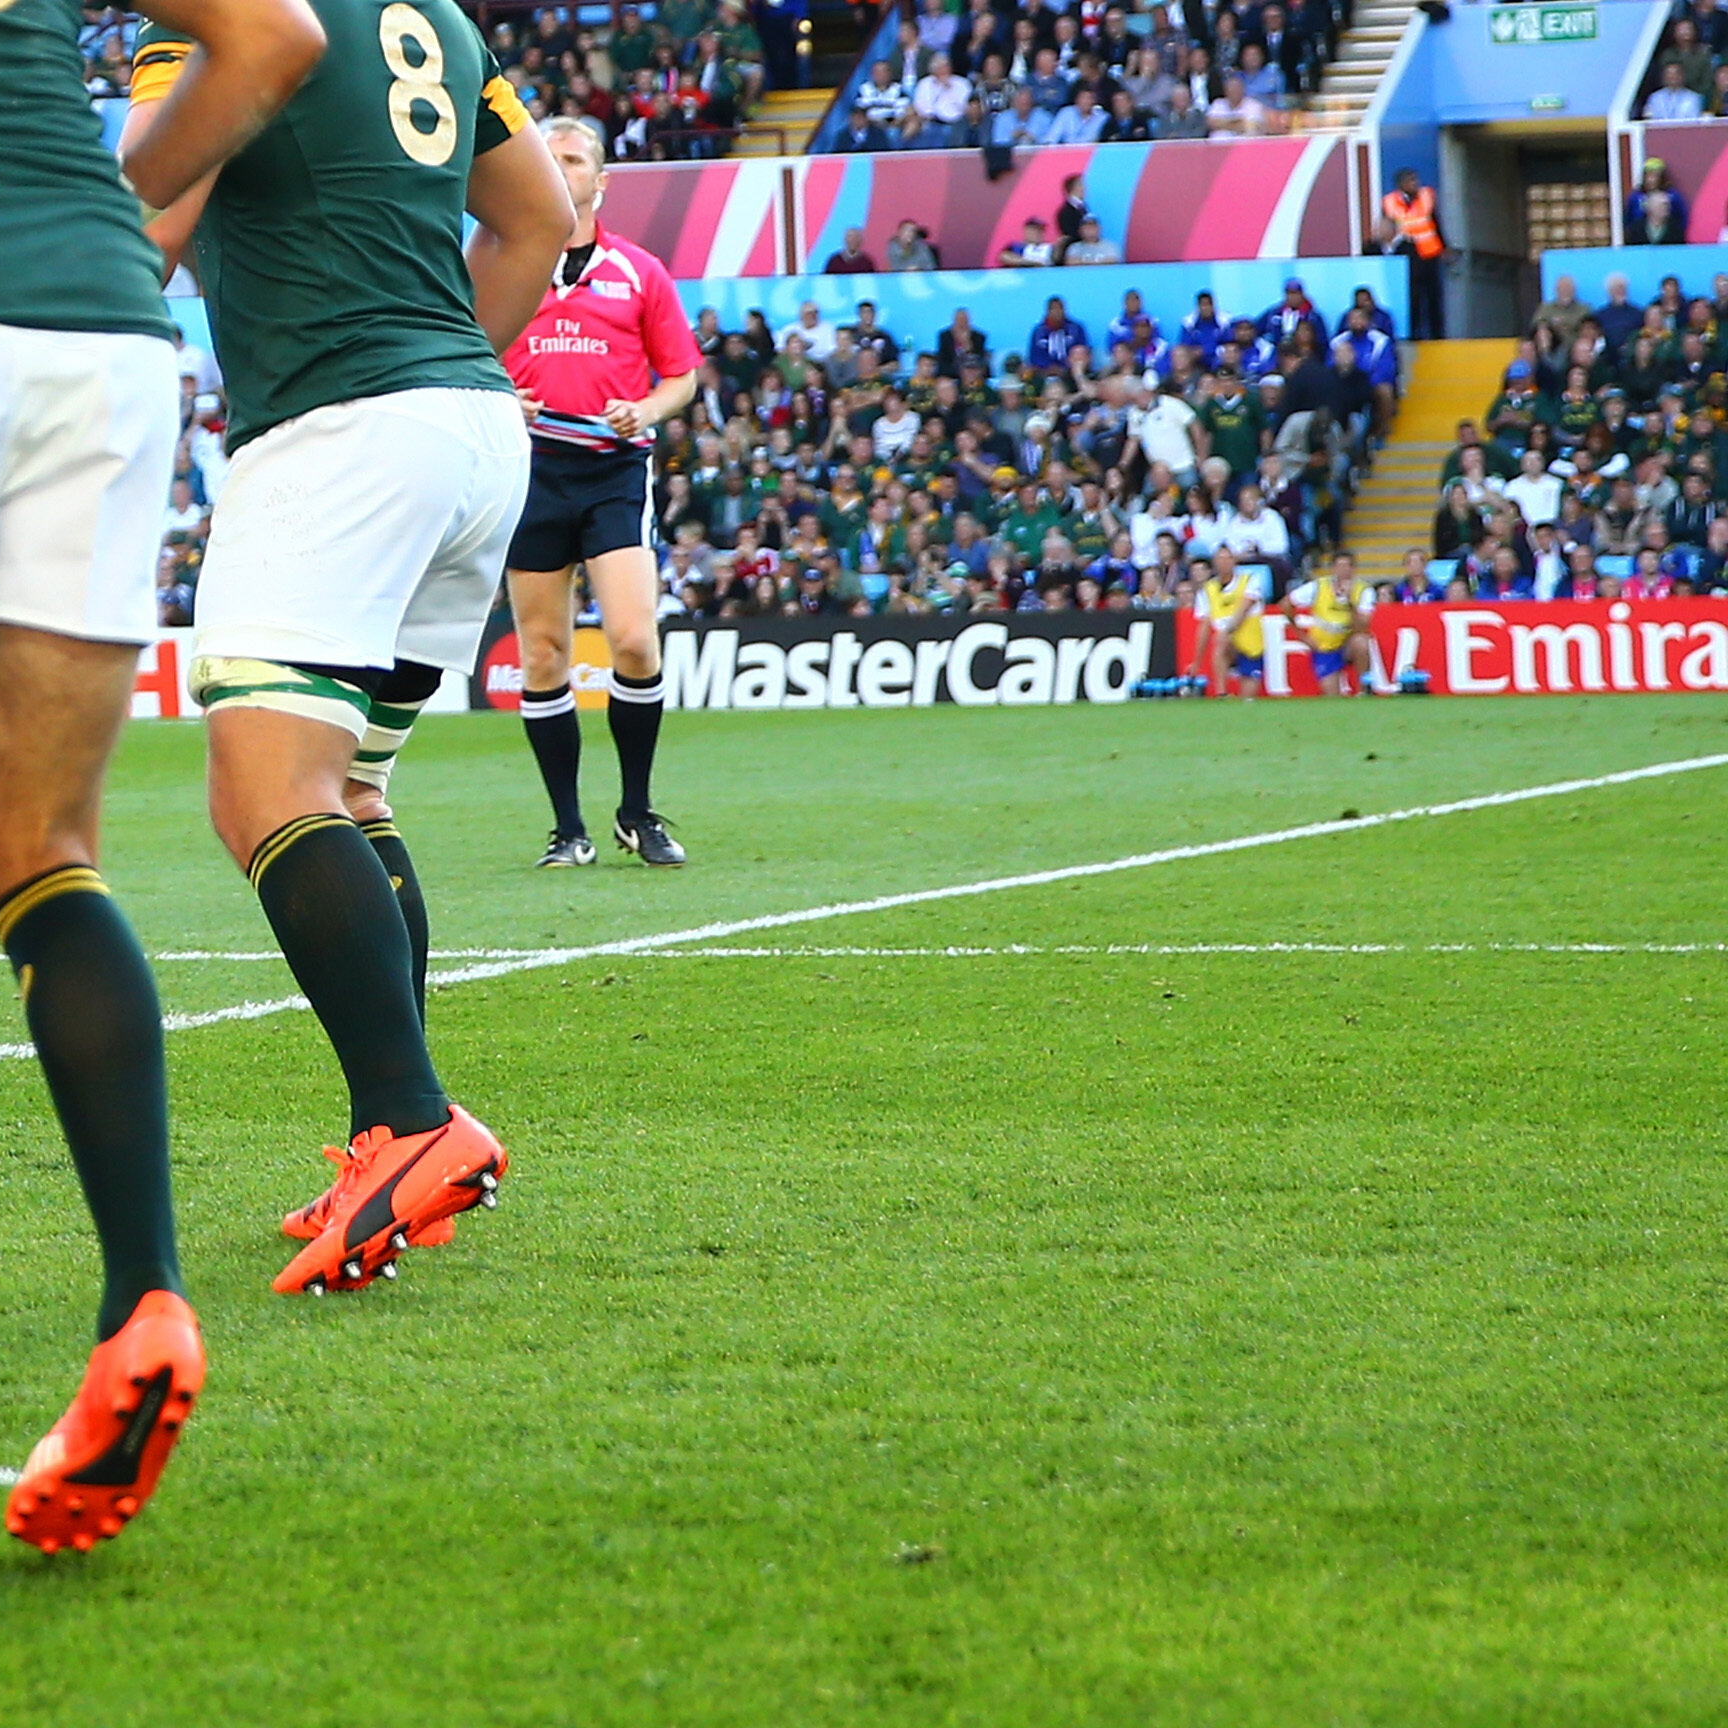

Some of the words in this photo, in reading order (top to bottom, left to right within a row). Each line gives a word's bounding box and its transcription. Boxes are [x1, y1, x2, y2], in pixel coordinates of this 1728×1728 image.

[1547, 11, 1595, 35] EXIT
[378, 2, 458, 168] 8
[555, 318, 581, 335] Fly
[528, 332, 610, 355] Emirates
[662, 619, 1154, 710] MasterCard
